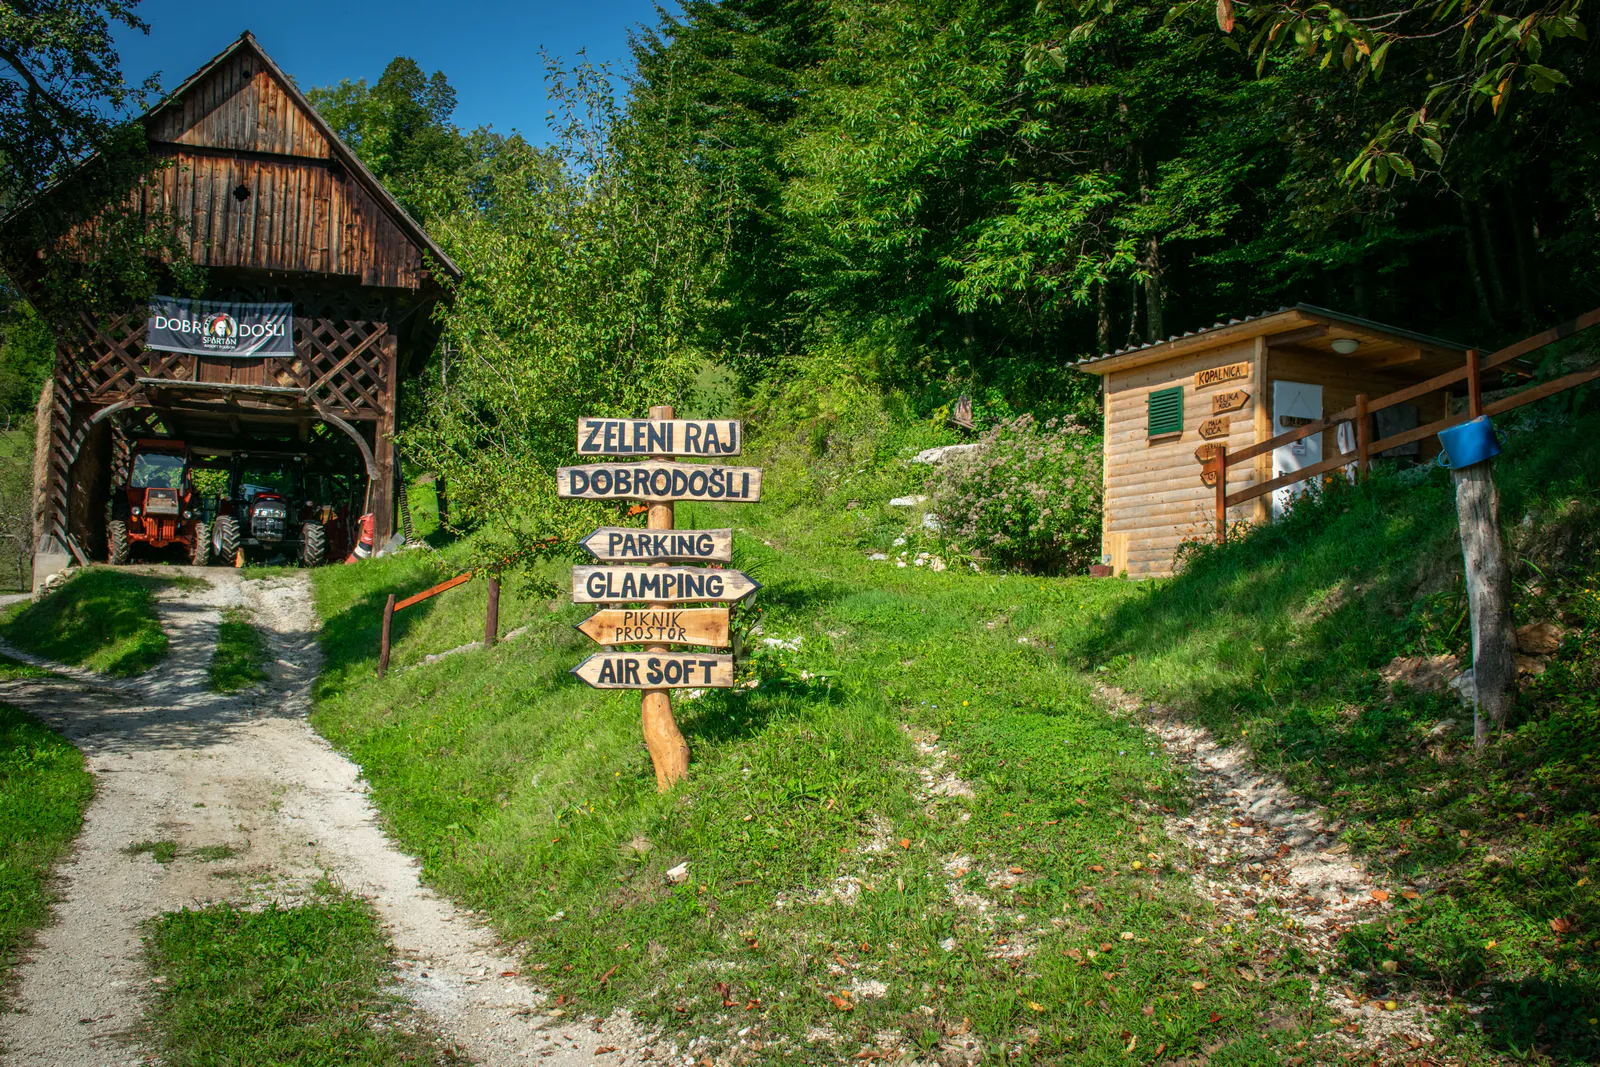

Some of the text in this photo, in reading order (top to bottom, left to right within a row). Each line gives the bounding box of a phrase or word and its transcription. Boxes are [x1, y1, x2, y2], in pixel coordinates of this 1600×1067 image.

[239, 321, 285, 337] DOŠLI
[202, 336, 237, 345] SPARTAN
[1198, 366, 1241, 385] KOPALNICA
[581, 421, 738, 454] ZELENI RAJ
[570, 468, 750, 498] DOBRODOŠLI
[608, 532, 715, 557] PARKING
[586, 571, 725, 599] GLAMPING
[623, 611, 684, 629] PIKNIK
[615, 626, 688, 642] PROSTOR
[597, 657, 718, 685] AIR SOFT
